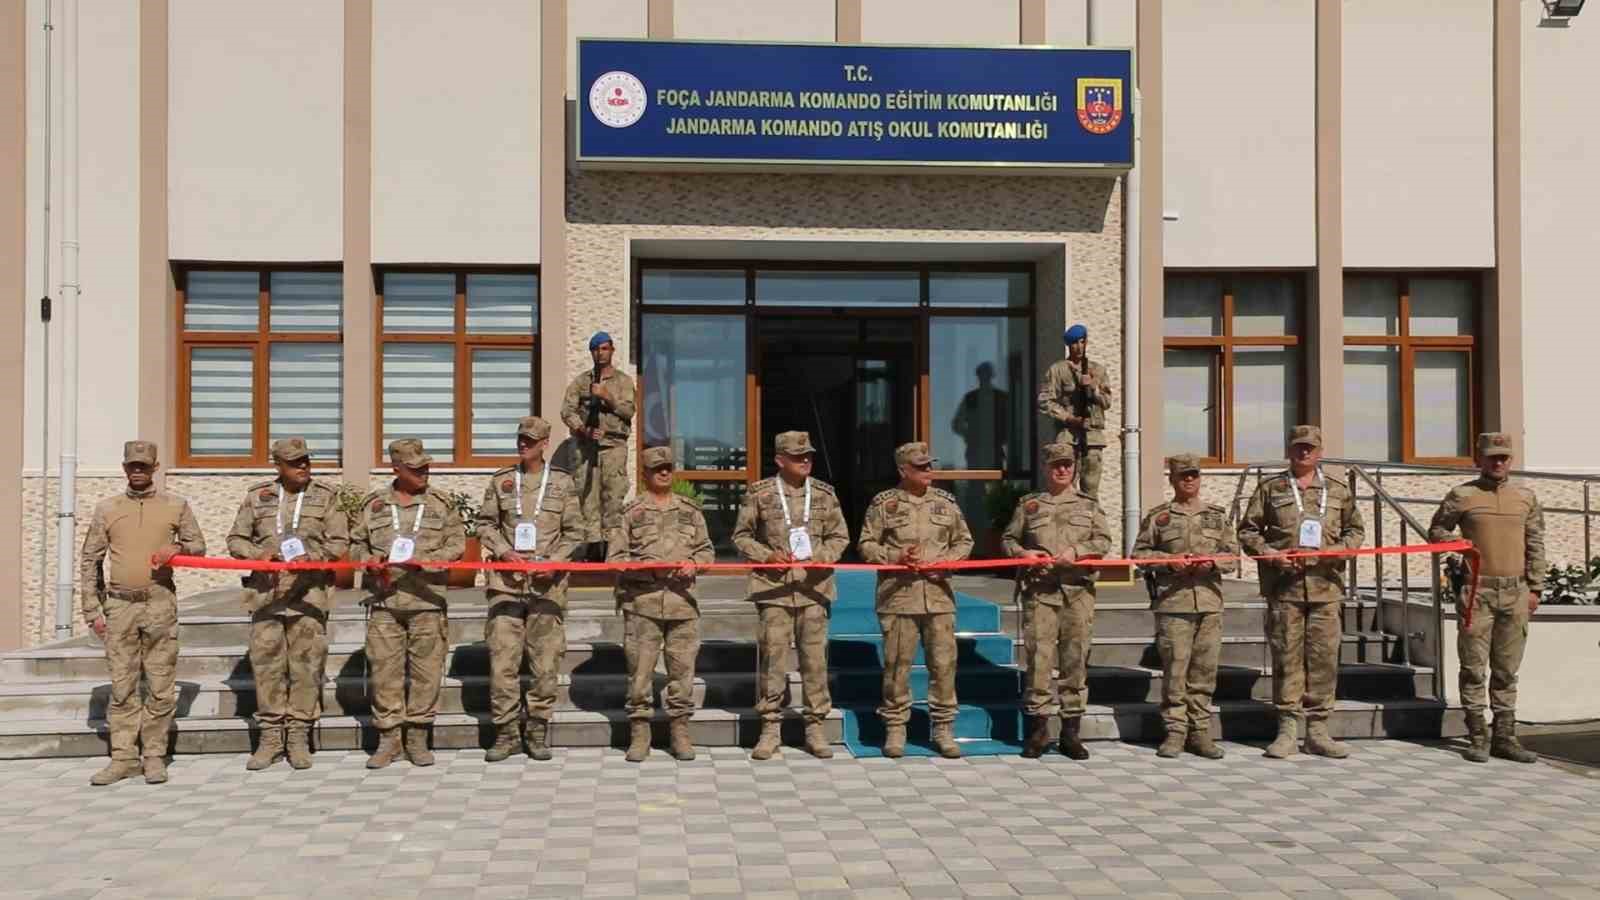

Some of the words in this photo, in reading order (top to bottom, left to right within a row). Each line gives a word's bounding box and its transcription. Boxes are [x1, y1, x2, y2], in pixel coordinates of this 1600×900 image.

[844, 65, 873, 81] T.C.
[656, 90, 701, 109] FOÇA
[705, 90, 795, 107] JANDARMA
[800, 92, 881, 109] KOMANDO
[886, 90, 942, 110] EĞİTİM
[947, 92, 1057, 111] KOMUTANLIĞI
[666, 118, 757, 135] JANDARMA
[761, 119, 842, 136] KOMANDO
[847, 121, 883, 141] ATIŞ
[888, 121, 933, 138] OKUL
[938, 120, 1048, 139] KOMUTANLIĞI
